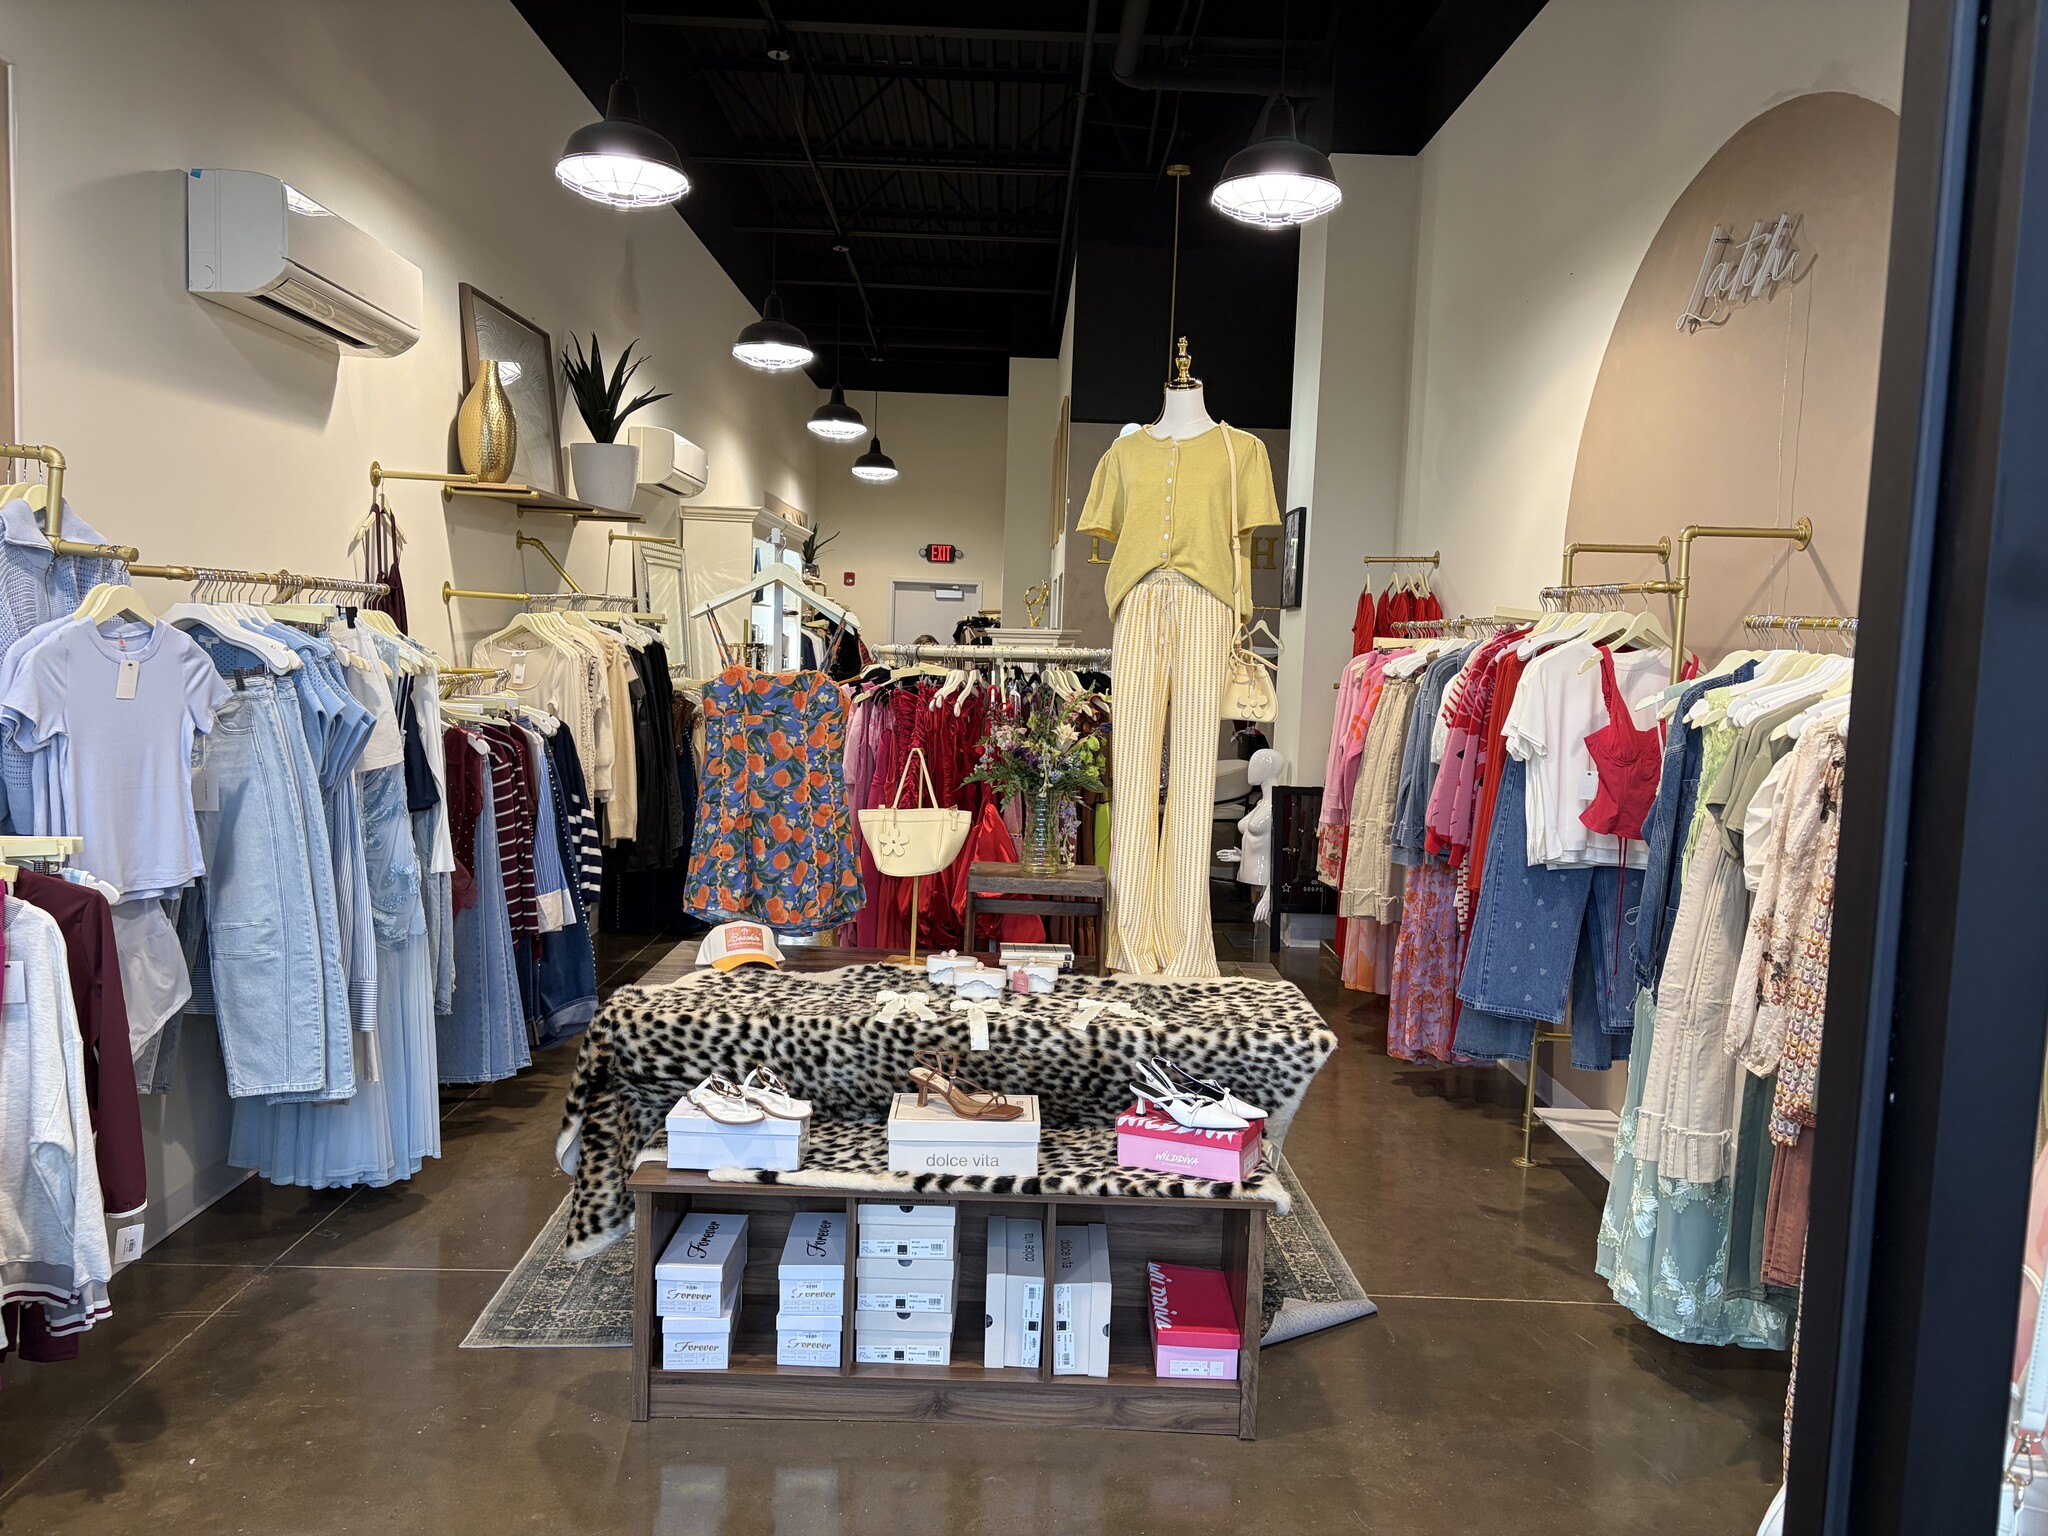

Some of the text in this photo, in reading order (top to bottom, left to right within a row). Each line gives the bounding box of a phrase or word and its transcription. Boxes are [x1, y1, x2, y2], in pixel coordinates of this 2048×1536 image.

[931, 545, 952, 561] EXIT
[926, 1154, 1000, 1167] dolce vita
[687, 1221, 720, 1258] Forever
[806, 1220, 832, 1257] Forever
[1024, 1232, 1035, 1262] dolce vita
[1061, 1239, 1073, 1268] dolce vita
[667, 1290, 712, 1301] Forever
[674, 1341, 720, 1352] Forever
